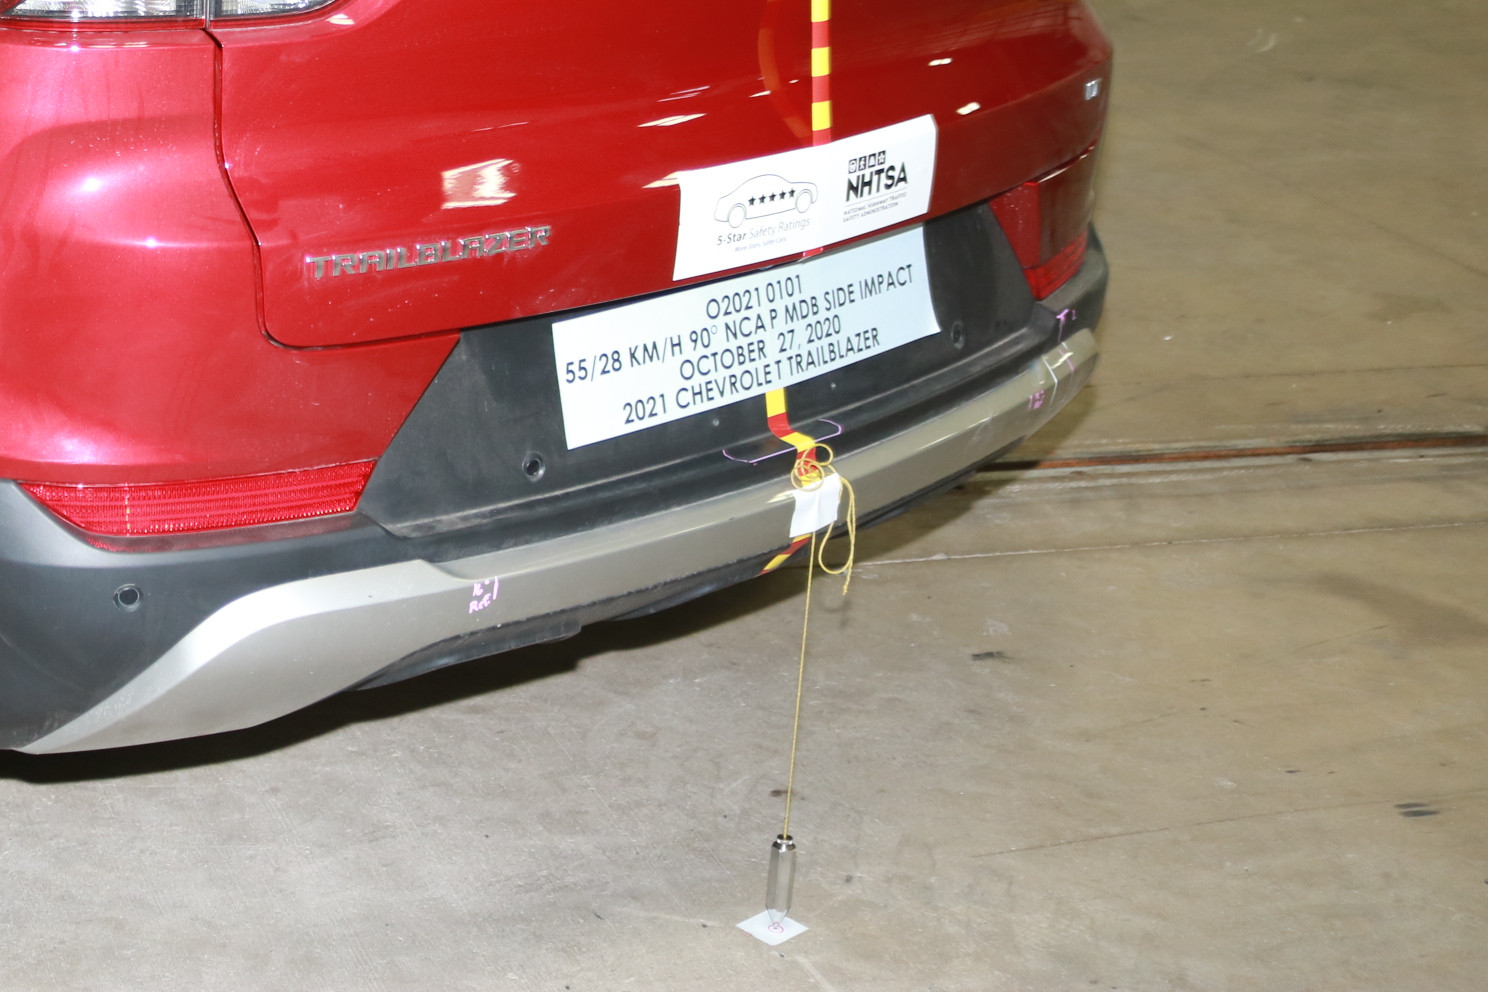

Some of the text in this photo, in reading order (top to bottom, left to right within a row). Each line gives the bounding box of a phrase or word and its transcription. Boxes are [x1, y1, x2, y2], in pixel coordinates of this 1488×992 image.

[845, 162, 908, 203] NHTSA
[306, 225, 551, 279] TRAILBLAZER
[717, 217, 811, 246] 5-Star Safety Ratings
[565, 264, 914, 384] 55/28 KM/H 90° NCAP MDB SIDE IMPACT
[680, 314, 842, 381] OCTOBER 27, 2020
[623, 327, 880, 424] 2021 CHEVROLET TRAILBLAZER
